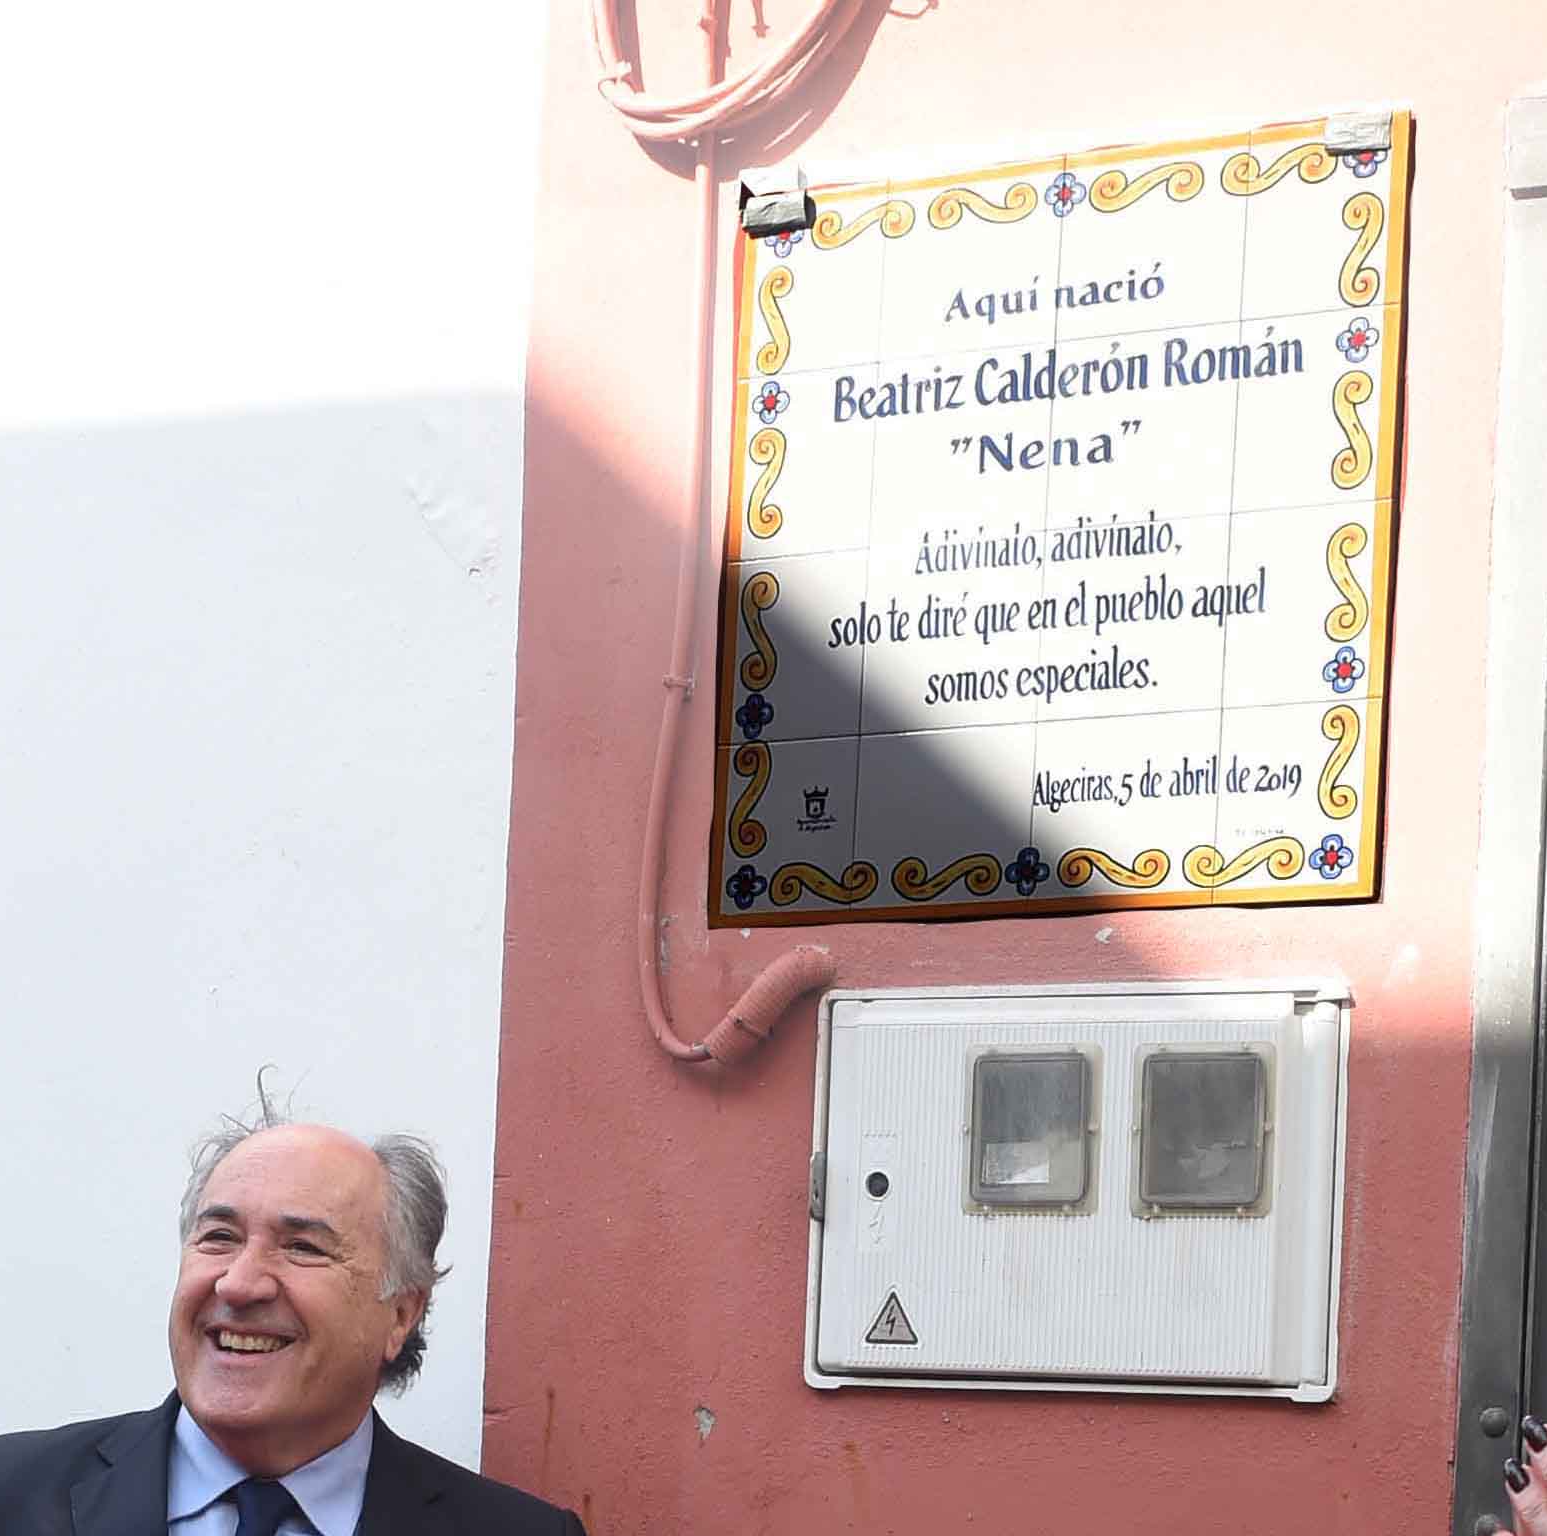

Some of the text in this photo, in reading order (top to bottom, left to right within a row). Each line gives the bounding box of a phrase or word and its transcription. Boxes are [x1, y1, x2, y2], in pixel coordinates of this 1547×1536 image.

[945, 262, 1165, 324] Aquí nació
[833, 326, 1304, 422] Beatriz Calderón Román
[1052, 510, 1182, 562] adivínalo,
[828, 566, 1266, 648] solo te diré que en el pueblo aquel
[925, 645, 1158, 705] somos especiales.
[1140, 759, 1162, 798] de
[1169, 757, 1217, 797] abril
[1226, 755, 1251, 793] de
[1254, 764, 1302, 798] 2019
